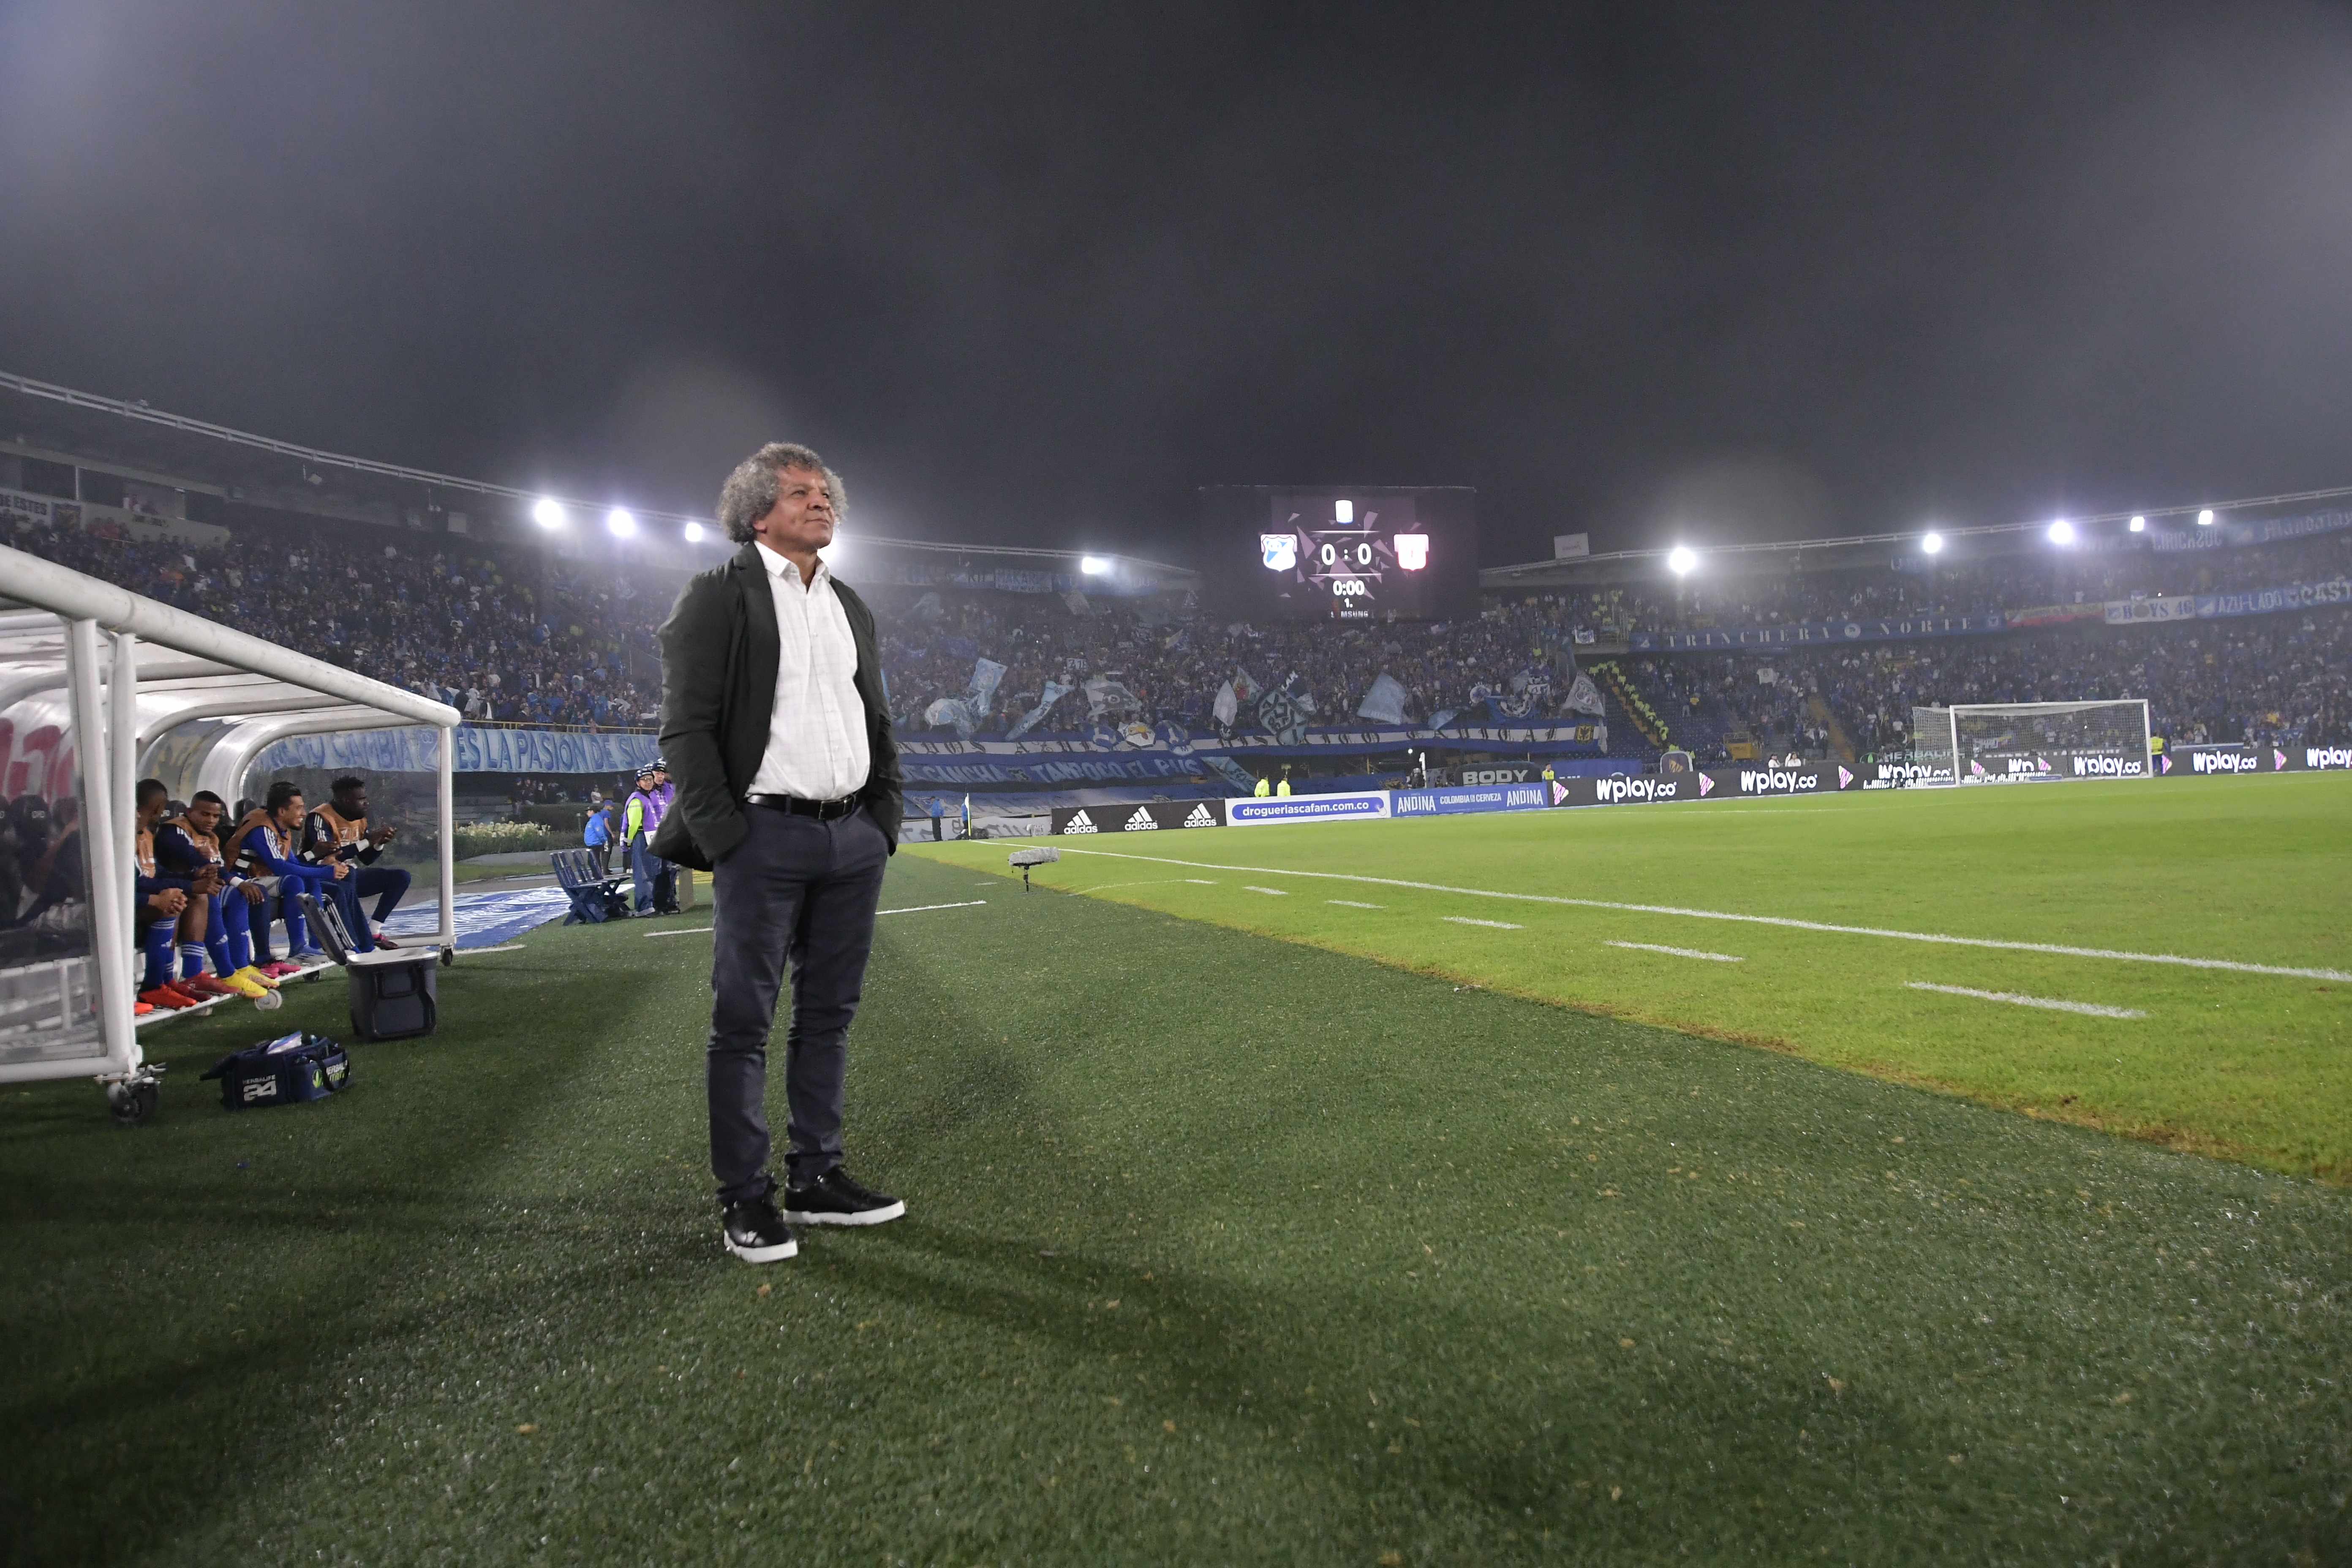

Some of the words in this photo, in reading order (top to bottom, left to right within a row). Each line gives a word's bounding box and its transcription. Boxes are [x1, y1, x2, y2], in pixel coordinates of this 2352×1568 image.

[1321, 543, 1336, 565] 0
[1358, 543, 1372, 565] 0
[1333, 580, 1365, 596] 0:00
[455, 728, 481, 770] ES
[482, 729, 512, 770] LA
[585, 733, 618, 771] DE
[2193, 750, 2257, 774] Wplay.co
[1462, 770, 1528, 783] BODY
[1741, 768, 1817, 794] Wplay.co
[1440, 795, 1470, 804] COLOMBIA
[1475, 793, 1502, 803] CERVEZA
[1506, 789, 1544, 807] ANDINA
[1597, 776, 1677, 803] Wplay.co
[1242, 802, 1369, 817] drogueriascafam.com.co
[1397, 795, 1436, 814] ANDINA
[1064, 825, 1098, 835] adidas
[1124, 820, 1158, 831] adidas
[1184, 818, 1217, 828] adidas
[243, 1080, 276, 1101] 24
